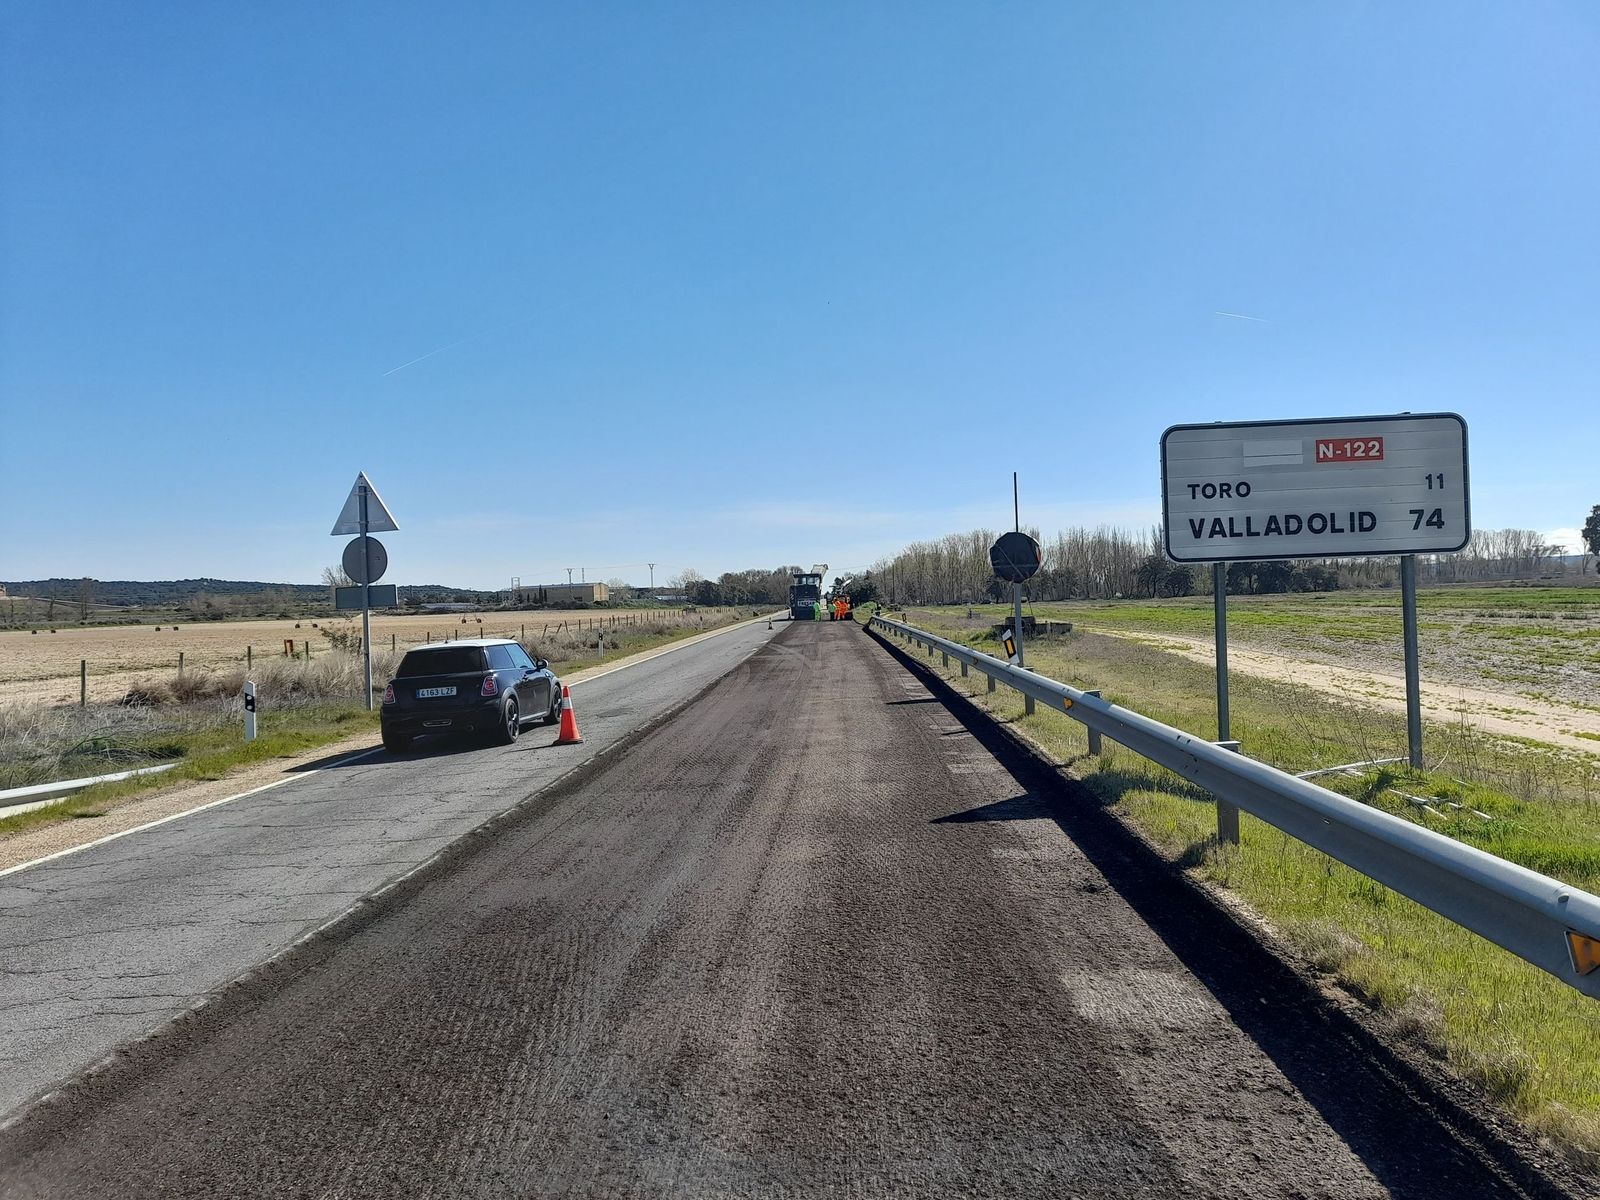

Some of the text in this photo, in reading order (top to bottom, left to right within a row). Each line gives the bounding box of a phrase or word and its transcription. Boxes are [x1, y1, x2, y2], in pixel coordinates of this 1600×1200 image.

[1319, 440, 1381, 459] N-122
[1187, 473, 1445, 500] TORO 11
[1189, 508, 1445, 539] VALLADOLID 74
[420, 688, 439, 697] 4163
